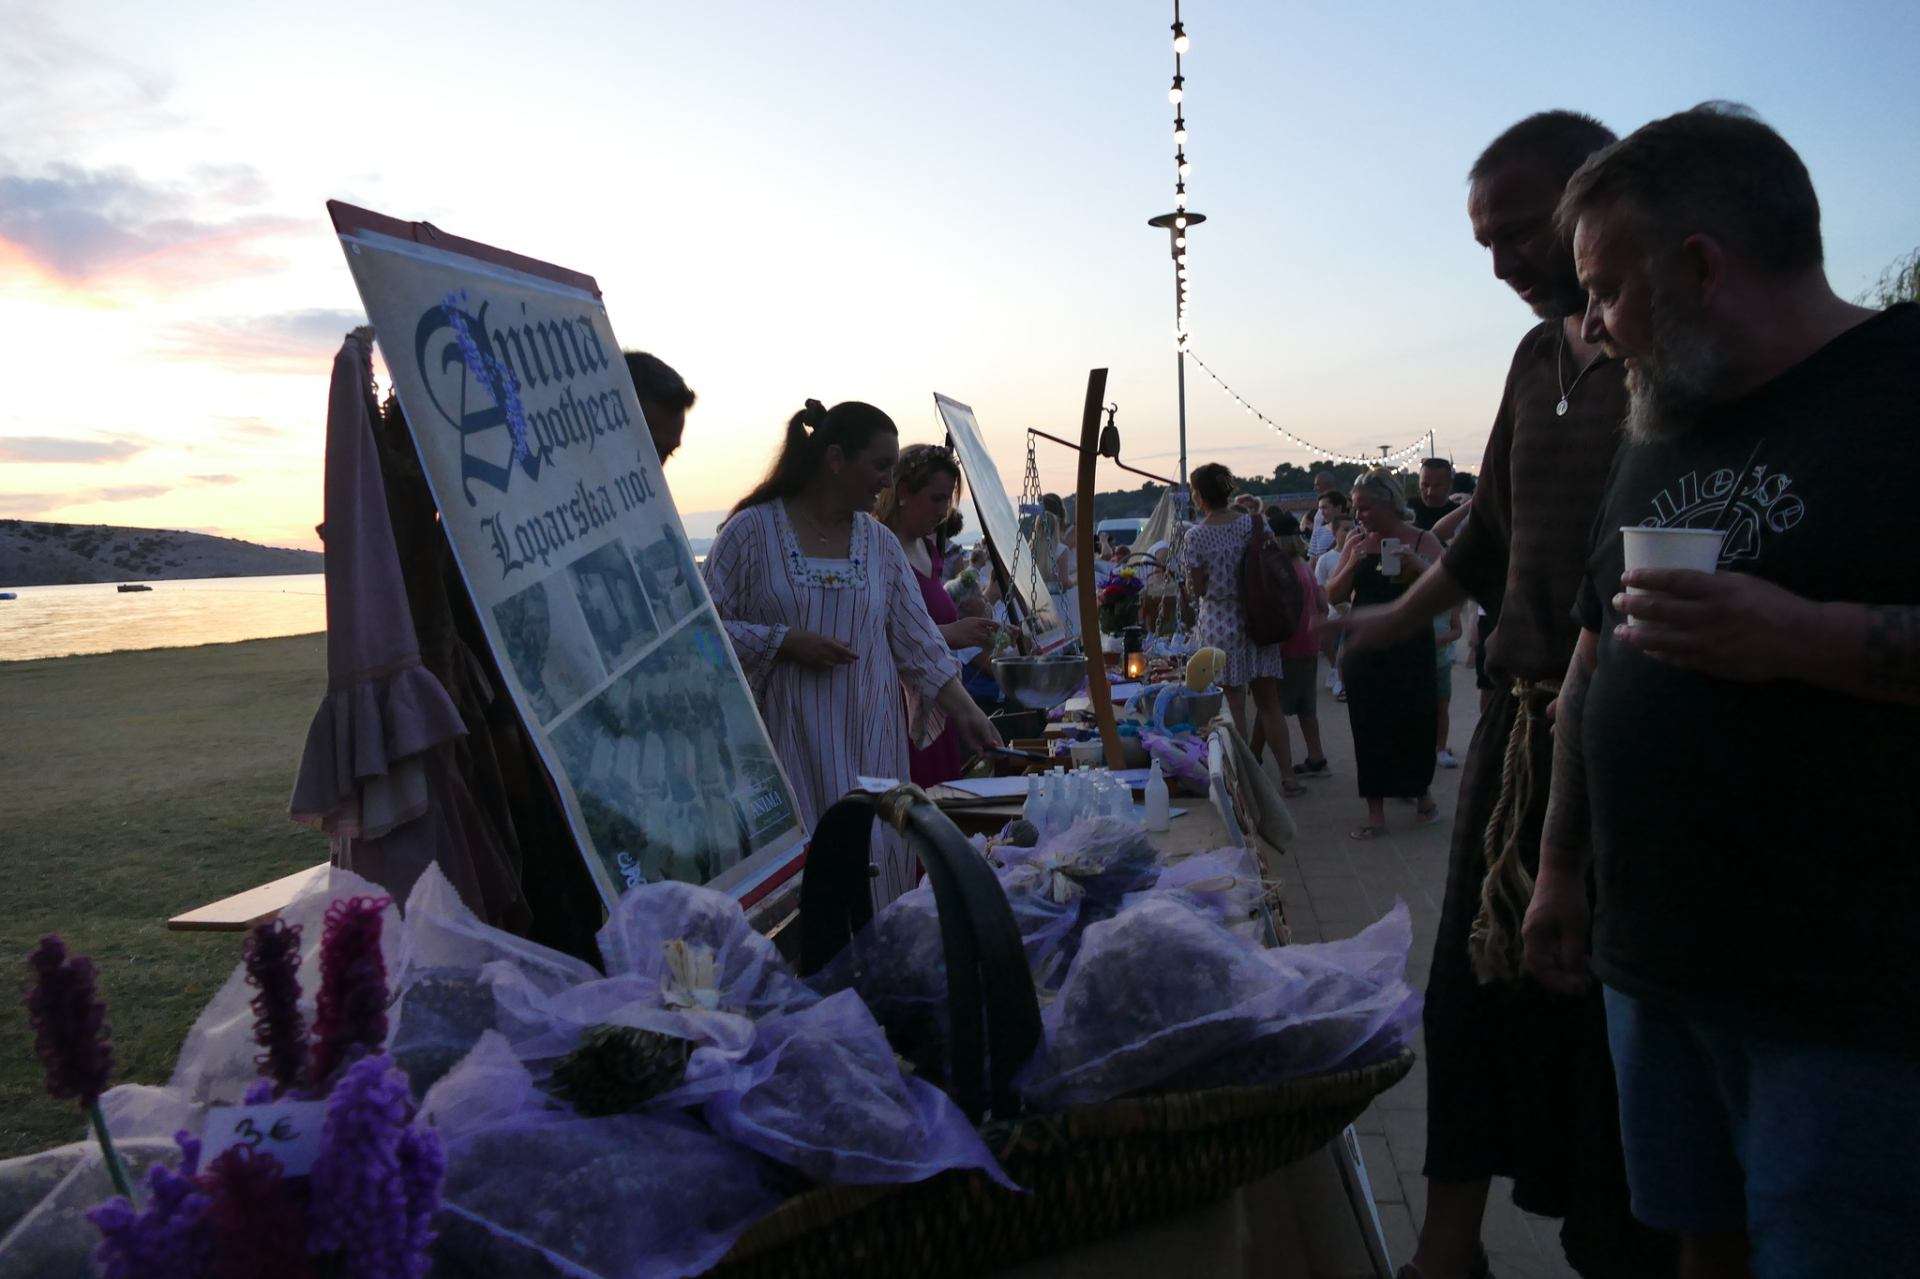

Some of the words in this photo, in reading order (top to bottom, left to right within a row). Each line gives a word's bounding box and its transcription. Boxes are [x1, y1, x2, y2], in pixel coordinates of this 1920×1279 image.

[415, 300, 608, 507] Anima
[480, 478, 616, 580] Loparska
[614, 450, 656, 511] noć
[234, 1117, 263, 1147] 3
